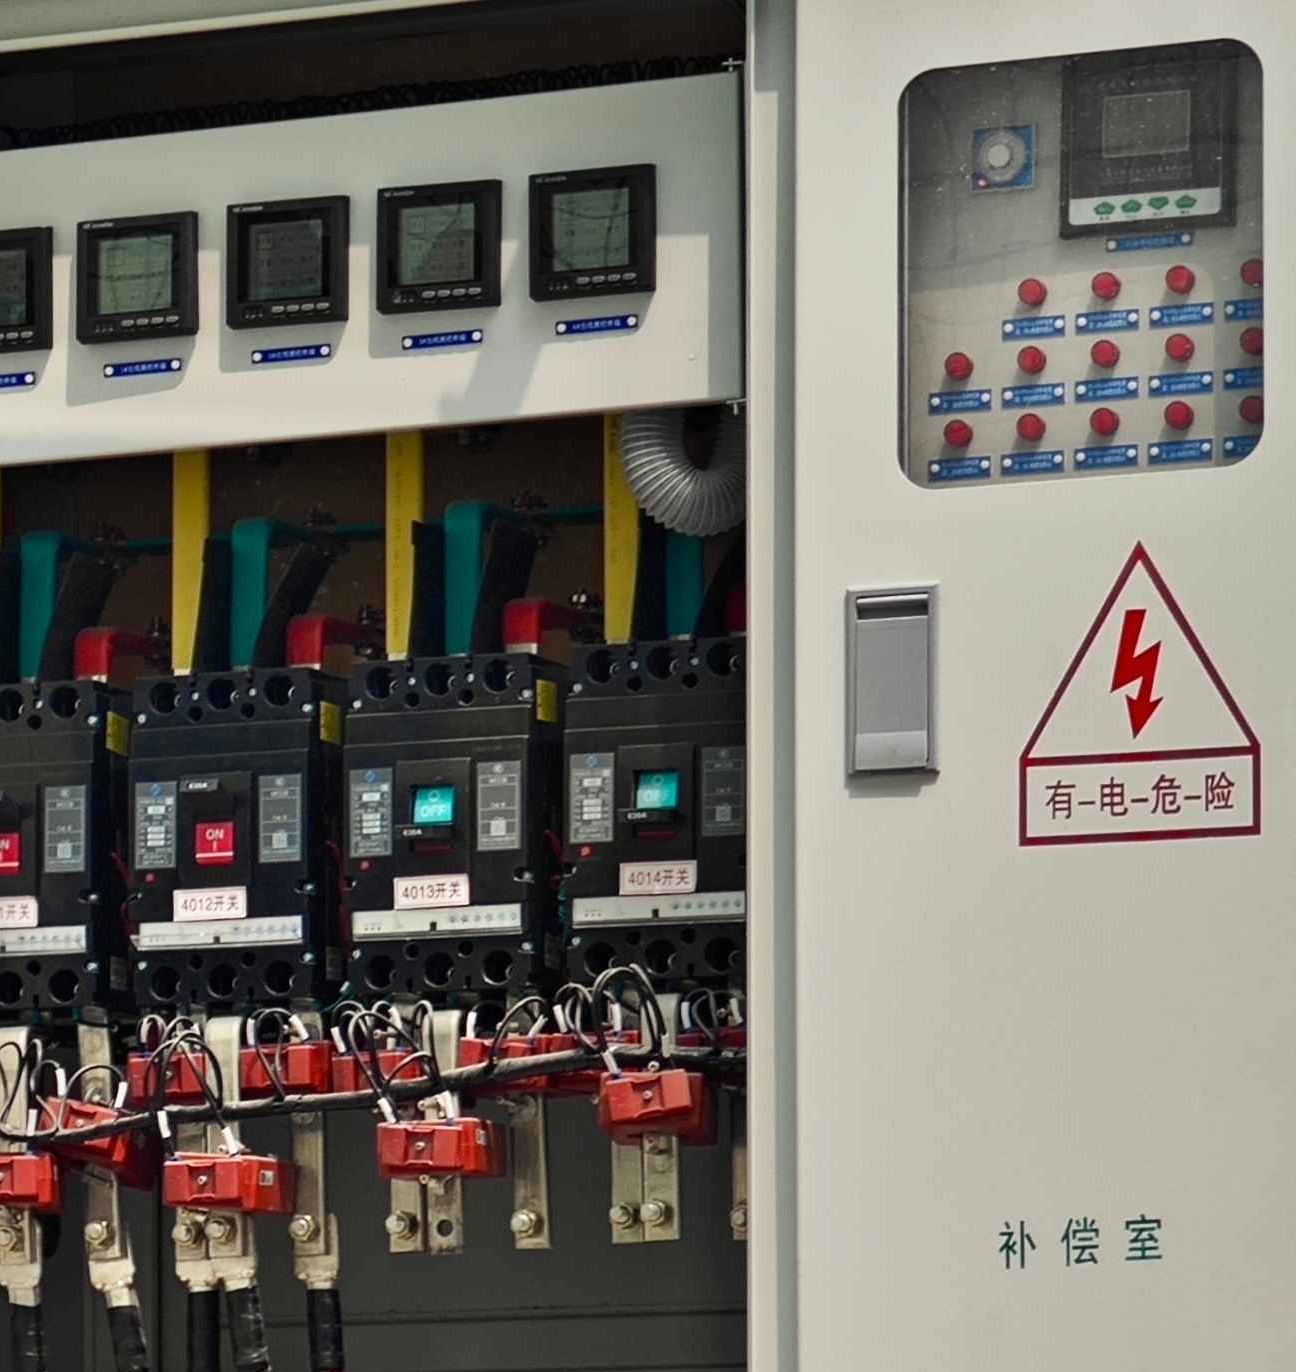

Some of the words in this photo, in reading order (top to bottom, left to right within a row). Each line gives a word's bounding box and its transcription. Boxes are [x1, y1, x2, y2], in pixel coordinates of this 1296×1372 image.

[419, 803, 448, 818] OFF
[205, 828, 225, 841] ON
[627, 866, 691, 887] 4014开关
[401, 879, 463, 900] 4013开关
[180, 894, 240, 913] 4012开关
[998, 1213, 1163, 1270] 补偿室
